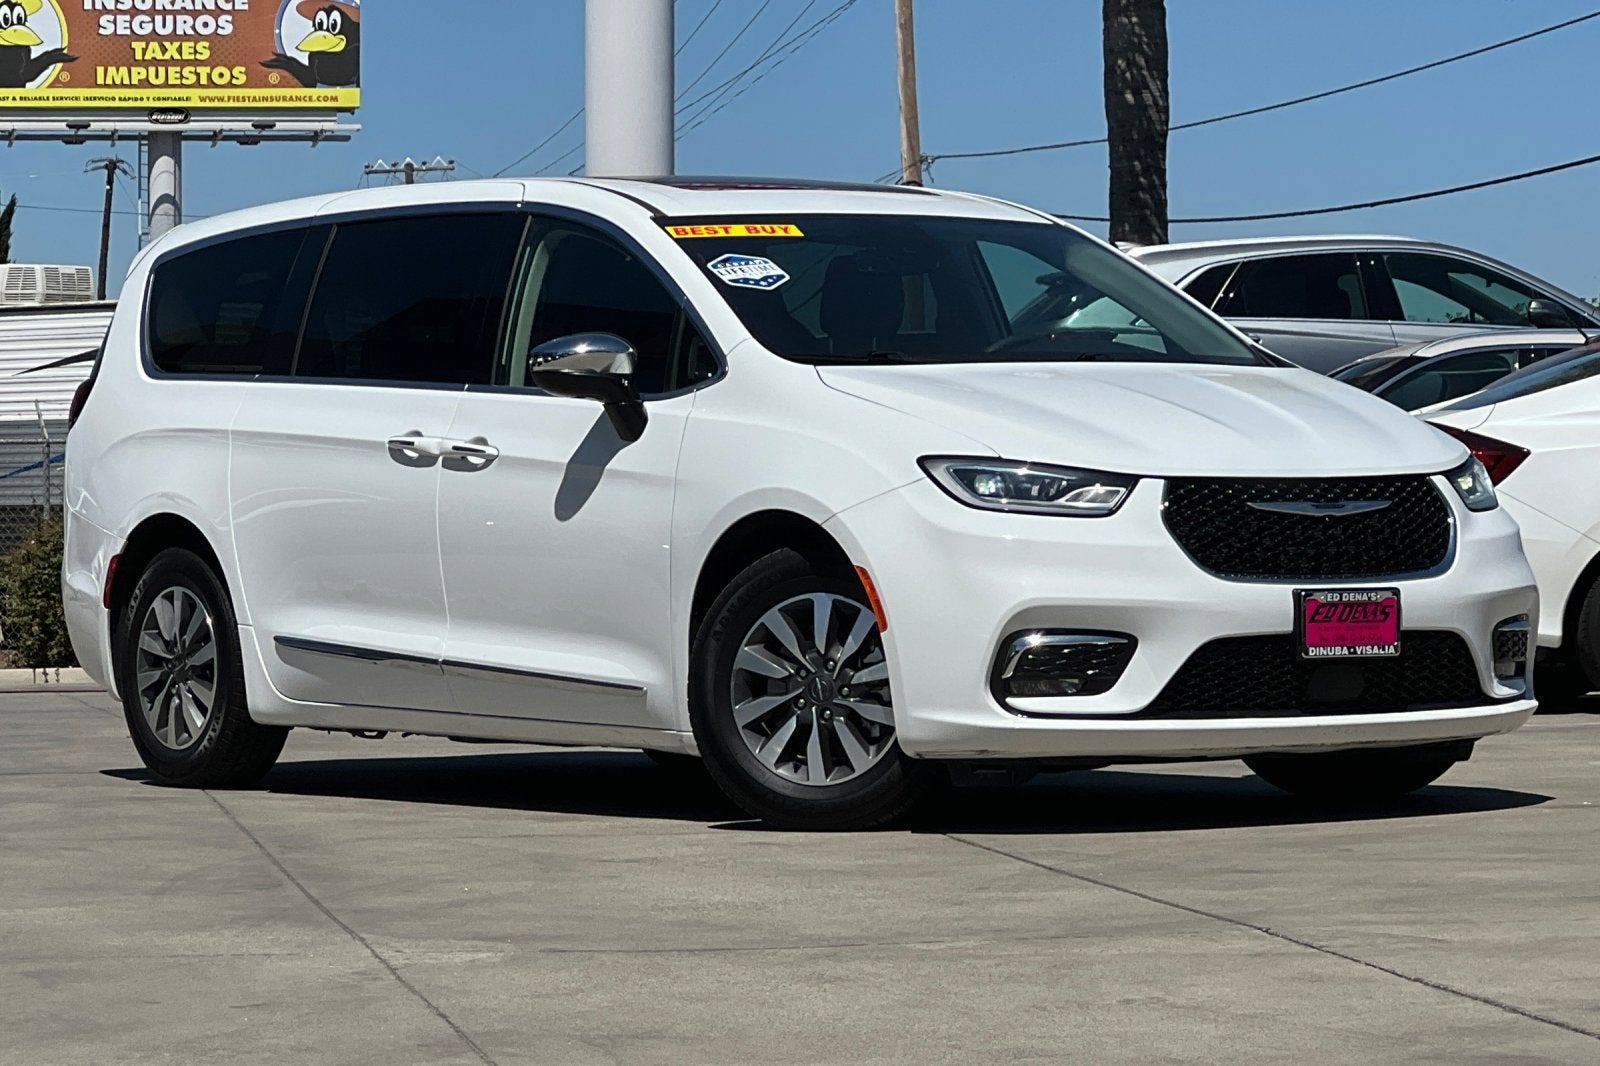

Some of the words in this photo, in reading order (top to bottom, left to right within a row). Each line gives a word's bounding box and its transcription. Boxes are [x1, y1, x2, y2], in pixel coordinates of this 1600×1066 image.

[98, 14, 234, 36] SEGUROS
[131, 41, 211, 61] TAXES
[96, 66, 247, 86] IMPUESTOS
[198, 95, 339, 103] WWW.FIESTAINSURANCE.COM
[673, 226, 732, 236] BEST
[744, 225, 792, 235] BUY
[1327, 593, 1340, 602] ED
[1342, 592, 1377, 601] DENA'S
[1308, 646, 1349, 656] DINUBA
[1355, 645, 1396, 655] VISALIA
